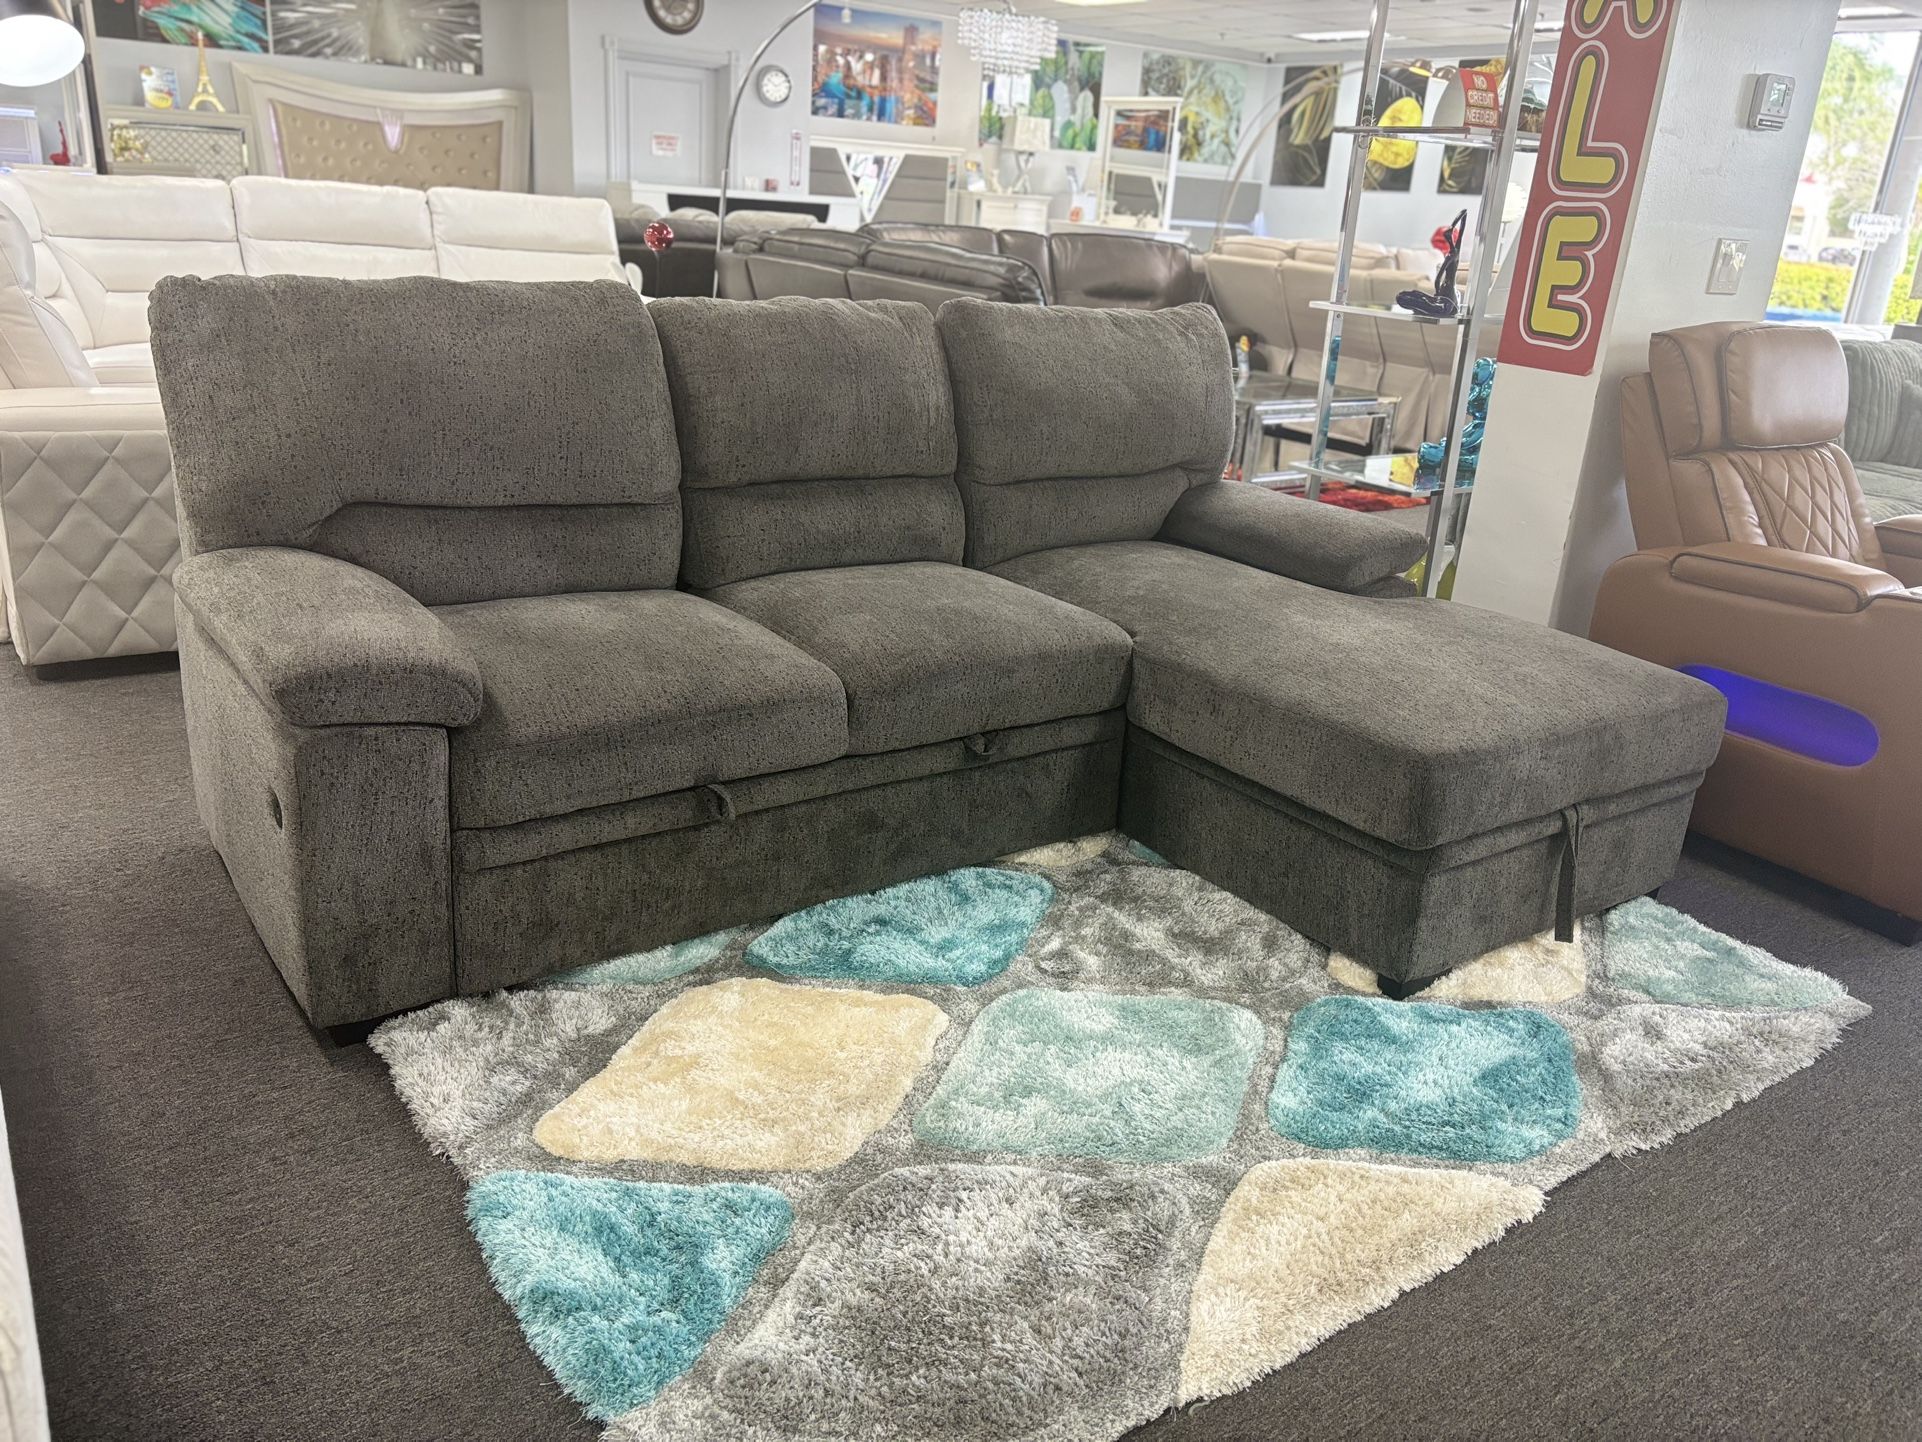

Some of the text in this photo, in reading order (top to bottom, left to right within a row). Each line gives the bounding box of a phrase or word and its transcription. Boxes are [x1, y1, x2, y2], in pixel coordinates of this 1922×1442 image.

[1472, 73, 1488, 90] NO
[1467, 89, 1495, 108] CREDIT
[1519, 0, 1667, 350] LE
